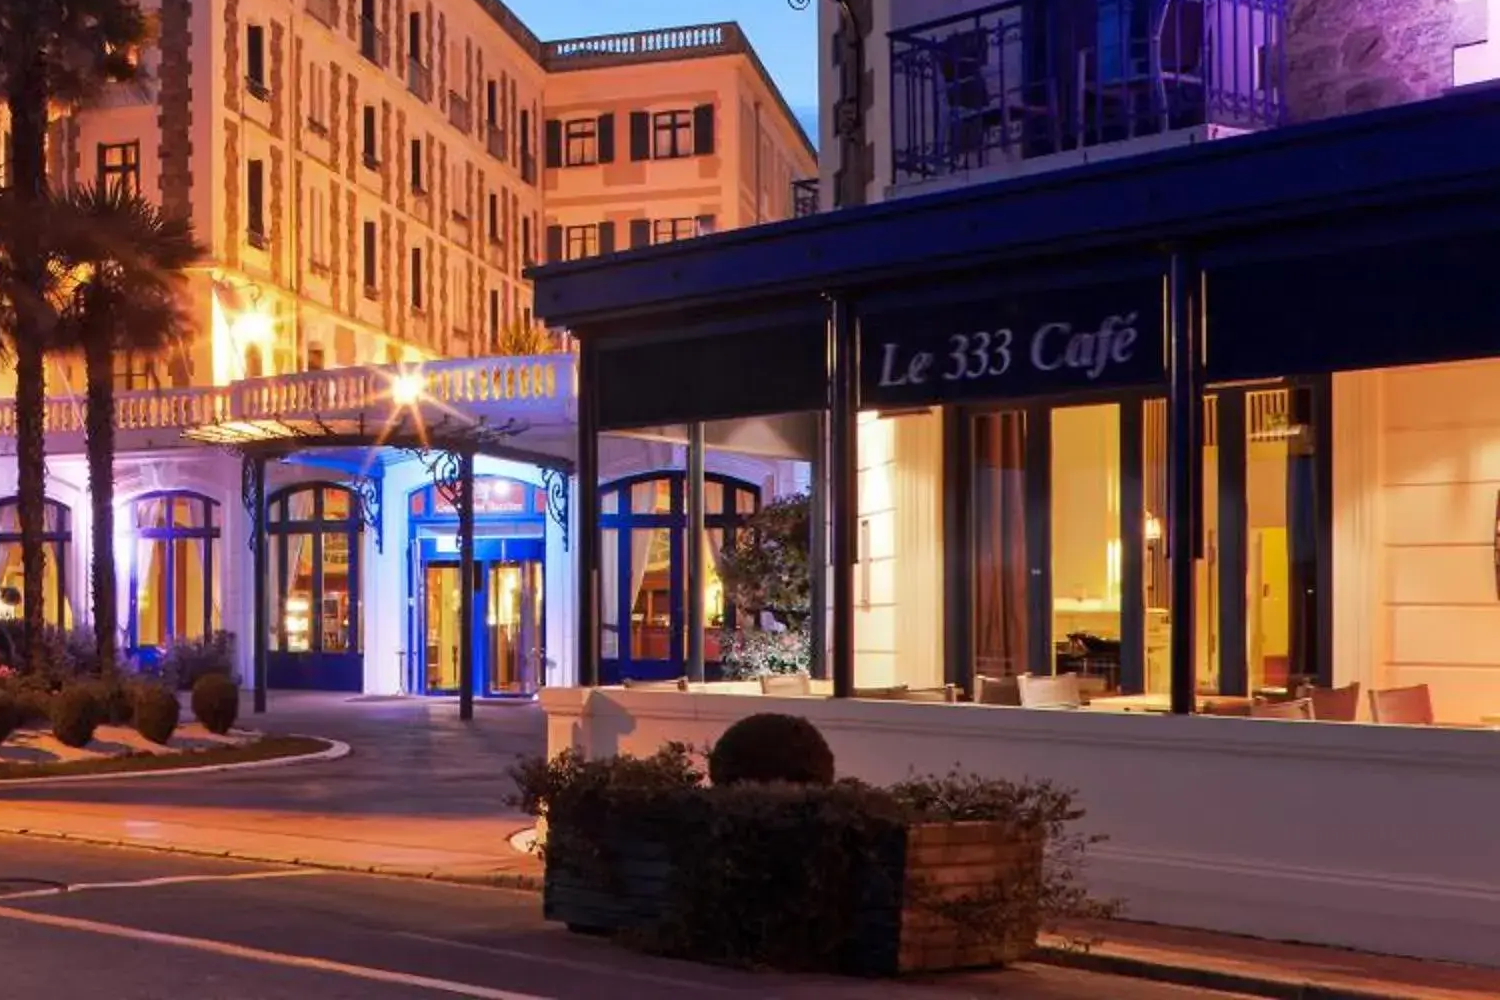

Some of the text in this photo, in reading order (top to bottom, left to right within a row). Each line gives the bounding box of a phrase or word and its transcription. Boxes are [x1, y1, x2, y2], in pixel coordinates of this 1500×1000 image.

[878, 311, 1139, 387] Le 333 Café
